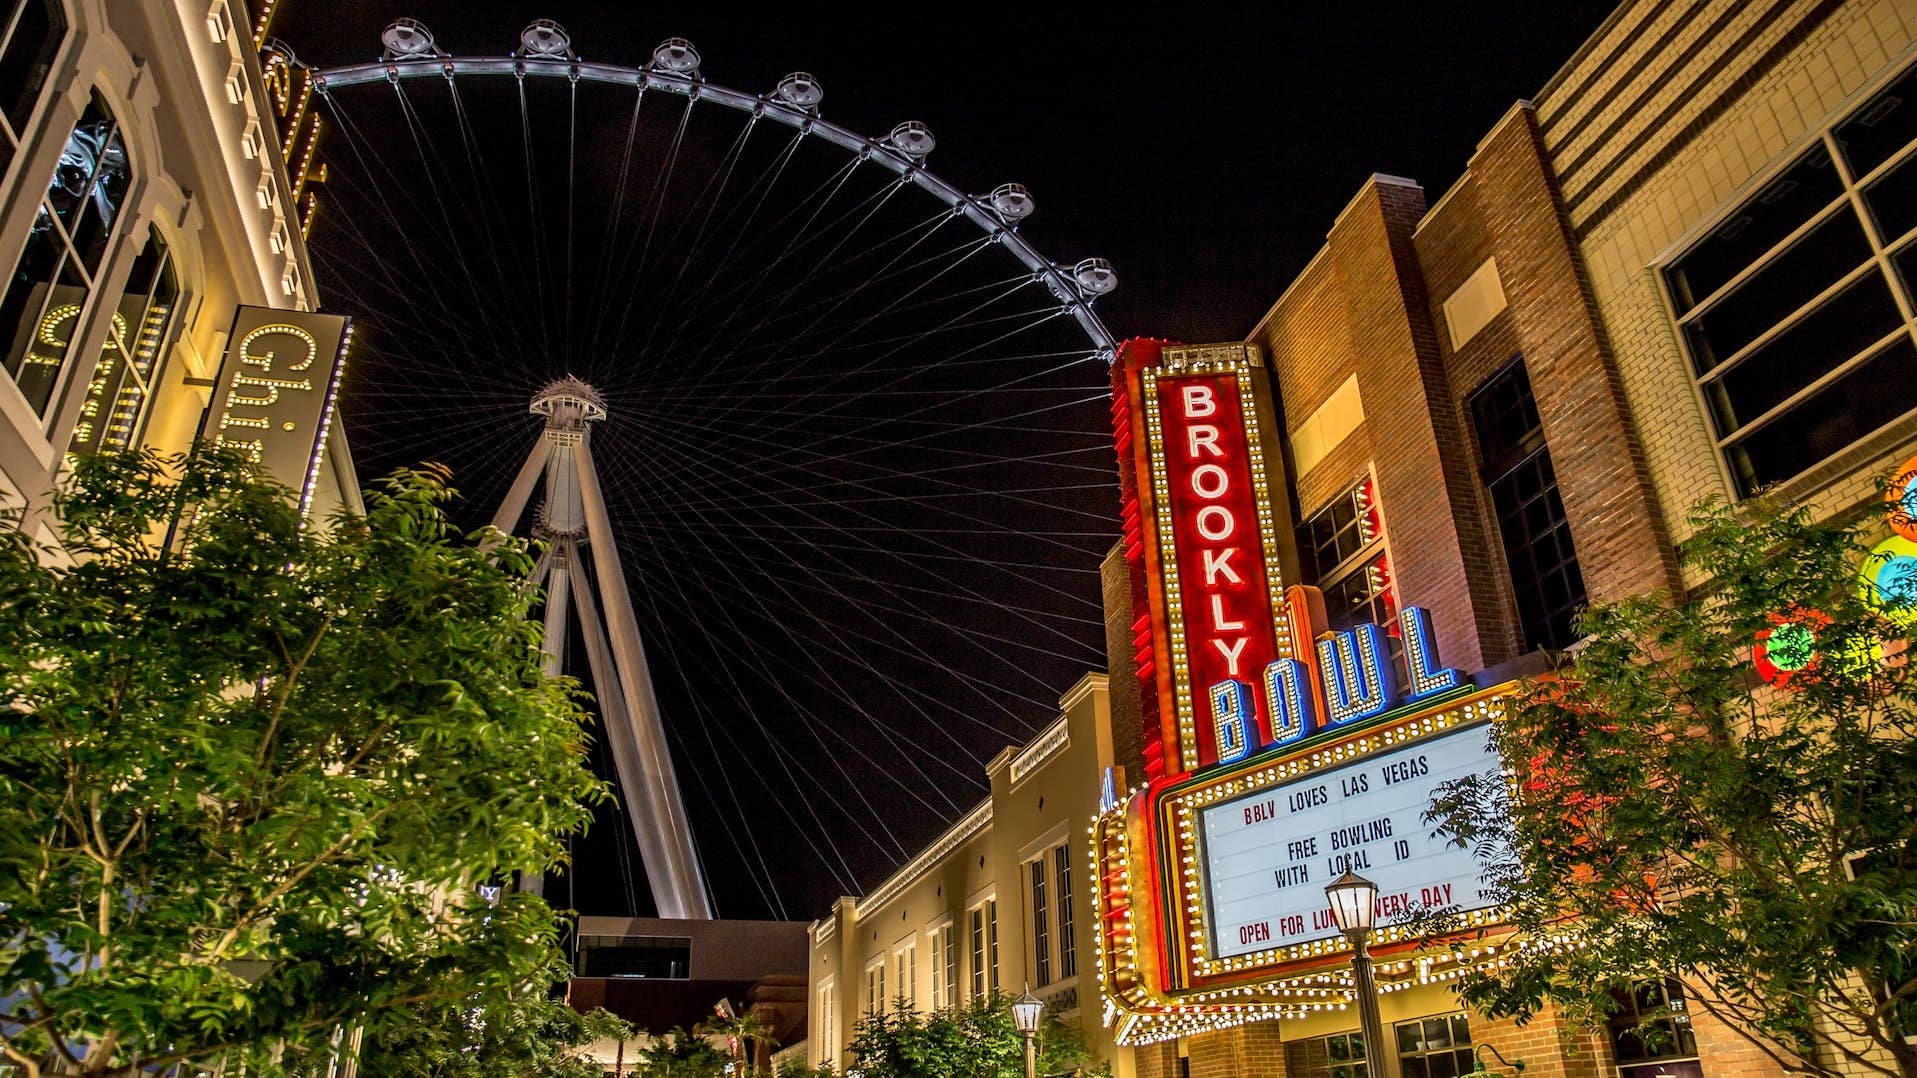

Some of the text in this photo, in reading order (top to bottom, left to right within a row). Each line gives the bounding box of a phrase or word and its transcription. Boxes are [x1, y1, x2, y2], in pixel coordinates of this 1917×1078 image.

[1182, 386, 1248, 675] BROOKLY
[1208, 606, 1458, 765] BOWL
[1244, 755, 1429, 825] BBLV LOVES LAS VEGAS
[1274, 864, 1309, 889] WITH
[1394, 840, 1410, 861] ID
[1288, 817, 1393, 861] FREE BOWLING
[1239, 883, 1453, 945] OPEN FOR LUN VERY DAY
